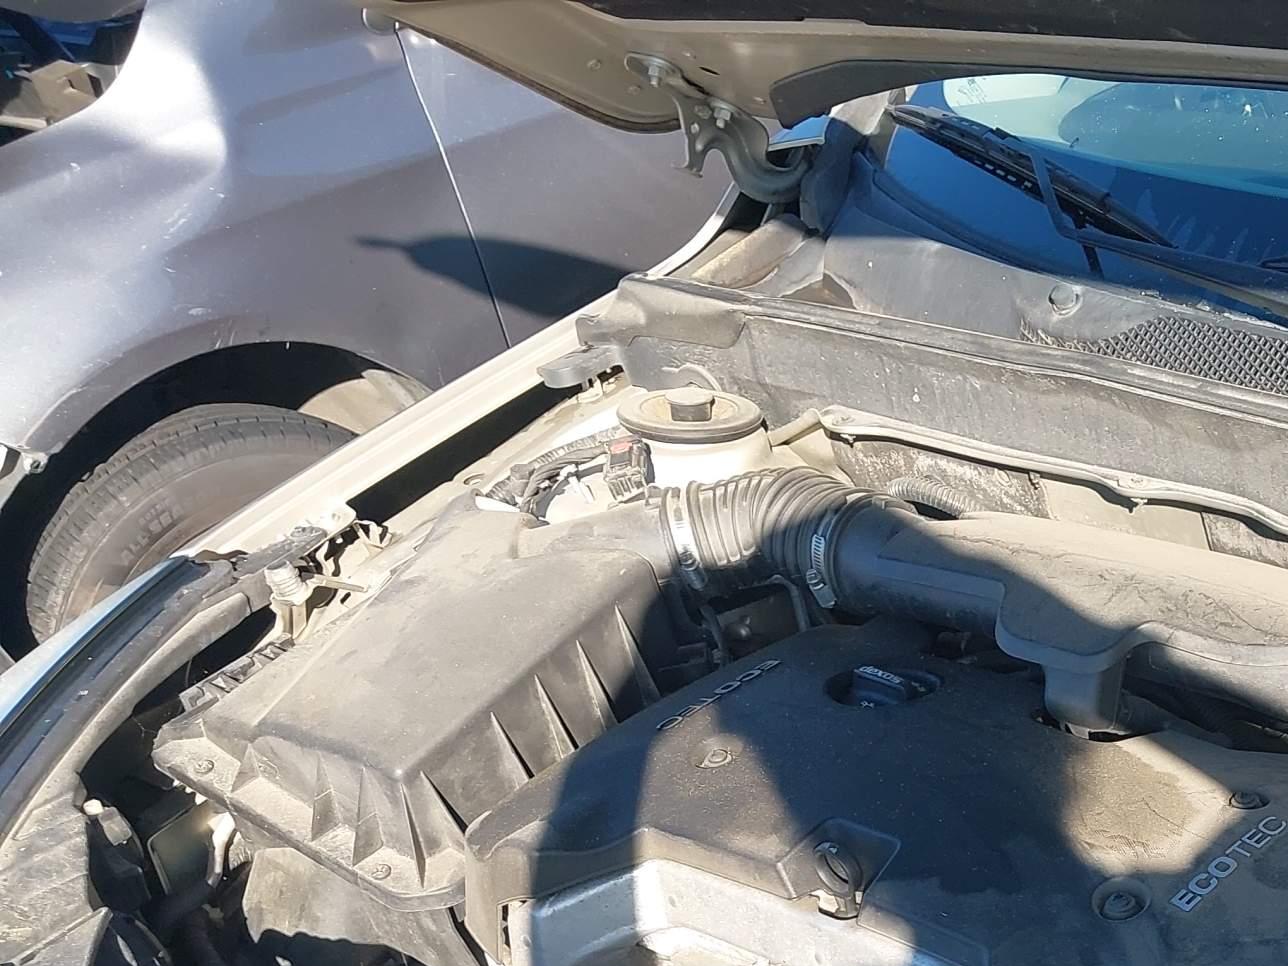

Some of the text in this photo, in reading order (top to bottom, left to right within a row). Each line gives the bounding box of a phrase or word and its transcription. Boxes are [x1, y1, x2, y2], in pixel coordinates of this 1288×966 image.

[655, 659, 783, 730] ECOTEC
[859, 665, 905, 684] dexos
[1168, 815, 1288, 912] ECOTEC
